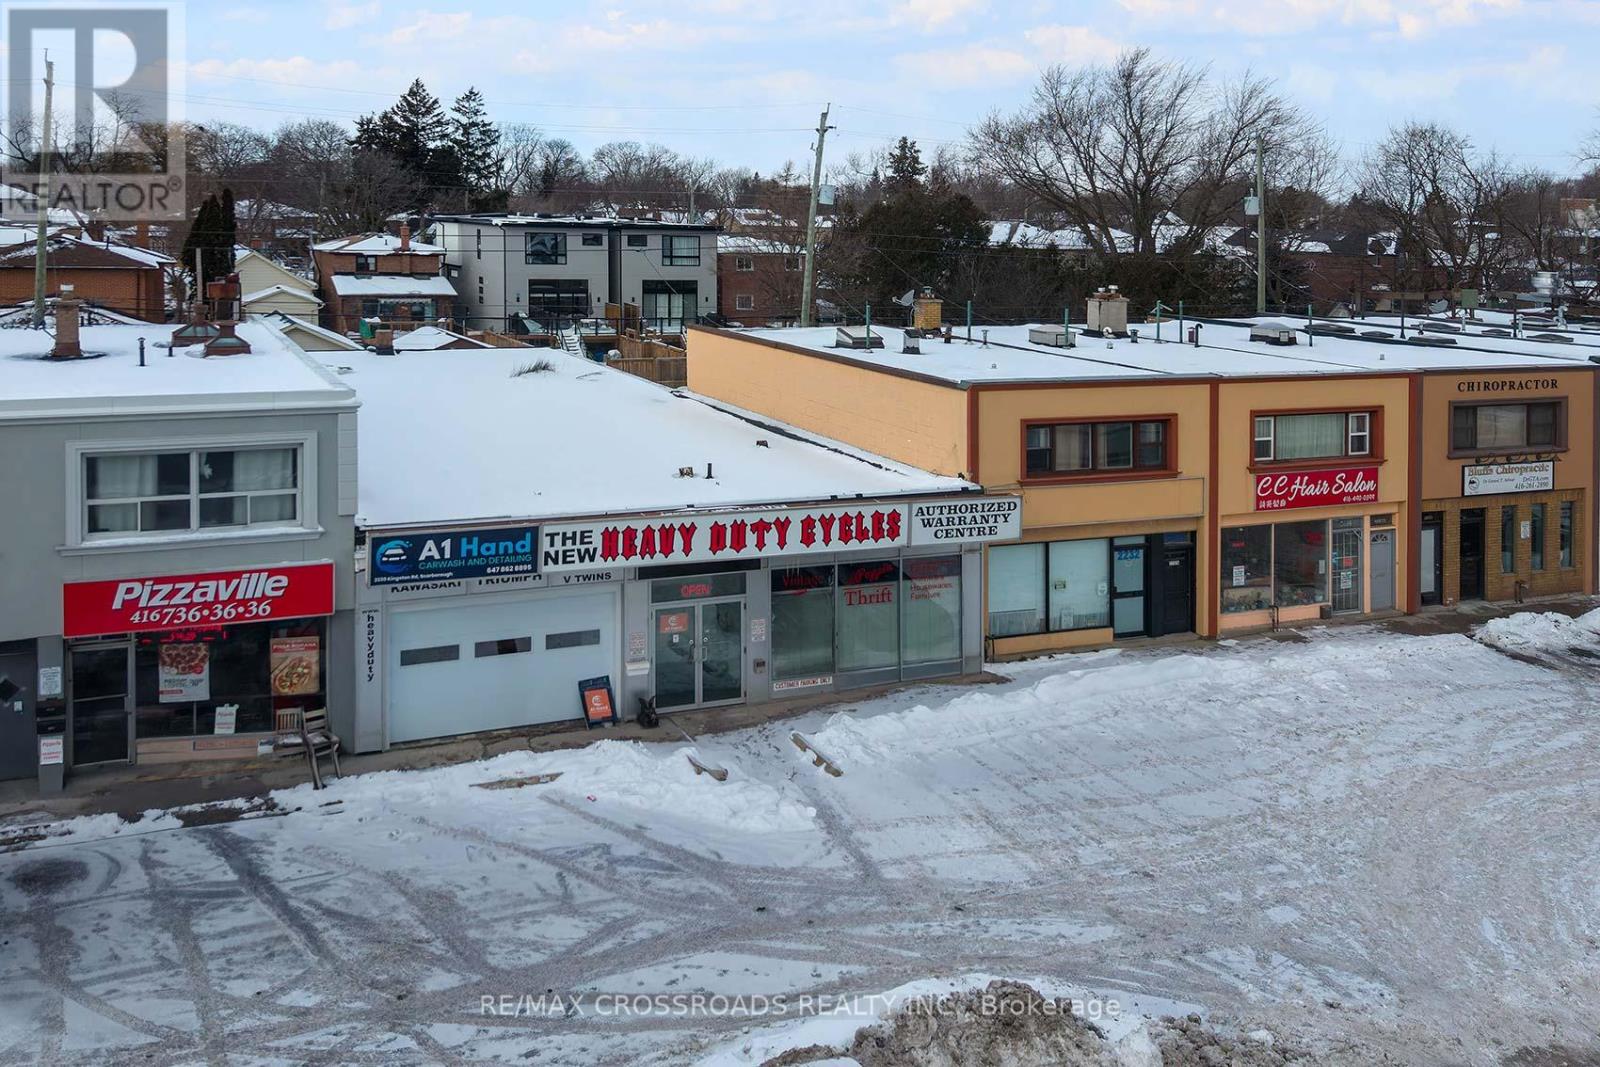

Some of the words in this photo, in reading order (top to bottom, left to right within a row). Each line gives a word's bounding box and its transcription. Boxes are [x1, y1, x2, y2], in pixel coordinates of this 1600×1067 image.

[1457, 379, 1558, 392] CHIROPRACTOR
[1468, 466, 1493, 477] Bluffs
[1287, 475, 1329, 501] Hair
[1332, 471, 1377, 495] Salon
[914, 501, 1018, 518] AUTHORIZED
[921, 513, 1012, 529] WARRANTY
[545, 529, 594, 548] THE
[600, 521, 698, 563] HEAVY
[708, 515, 792, 556] DUTY
[799, 508, 902, 548] CYCLES
[934, 525, 998, 540] CENTRE
[418, 538, 452, 561] A1
[460, 532, 532, 558] Hand
[418, 559, 465, 570] CARWASH
[468, 557, 487, 566] AND
[488, 554, 532, 564] DETAILING
[543, 546, 598, 567] NEW
[486, 566, 500, 574] 647
[563, 575, 572, 584] V
[574, 572, 612, 583] TWINS
[112, 572, 290, 611] Pizzaville
[680, 583, 712, 598] OPEN
[843, 586, 893, 606] Thrift
[130, 610, 161, 625] 416
